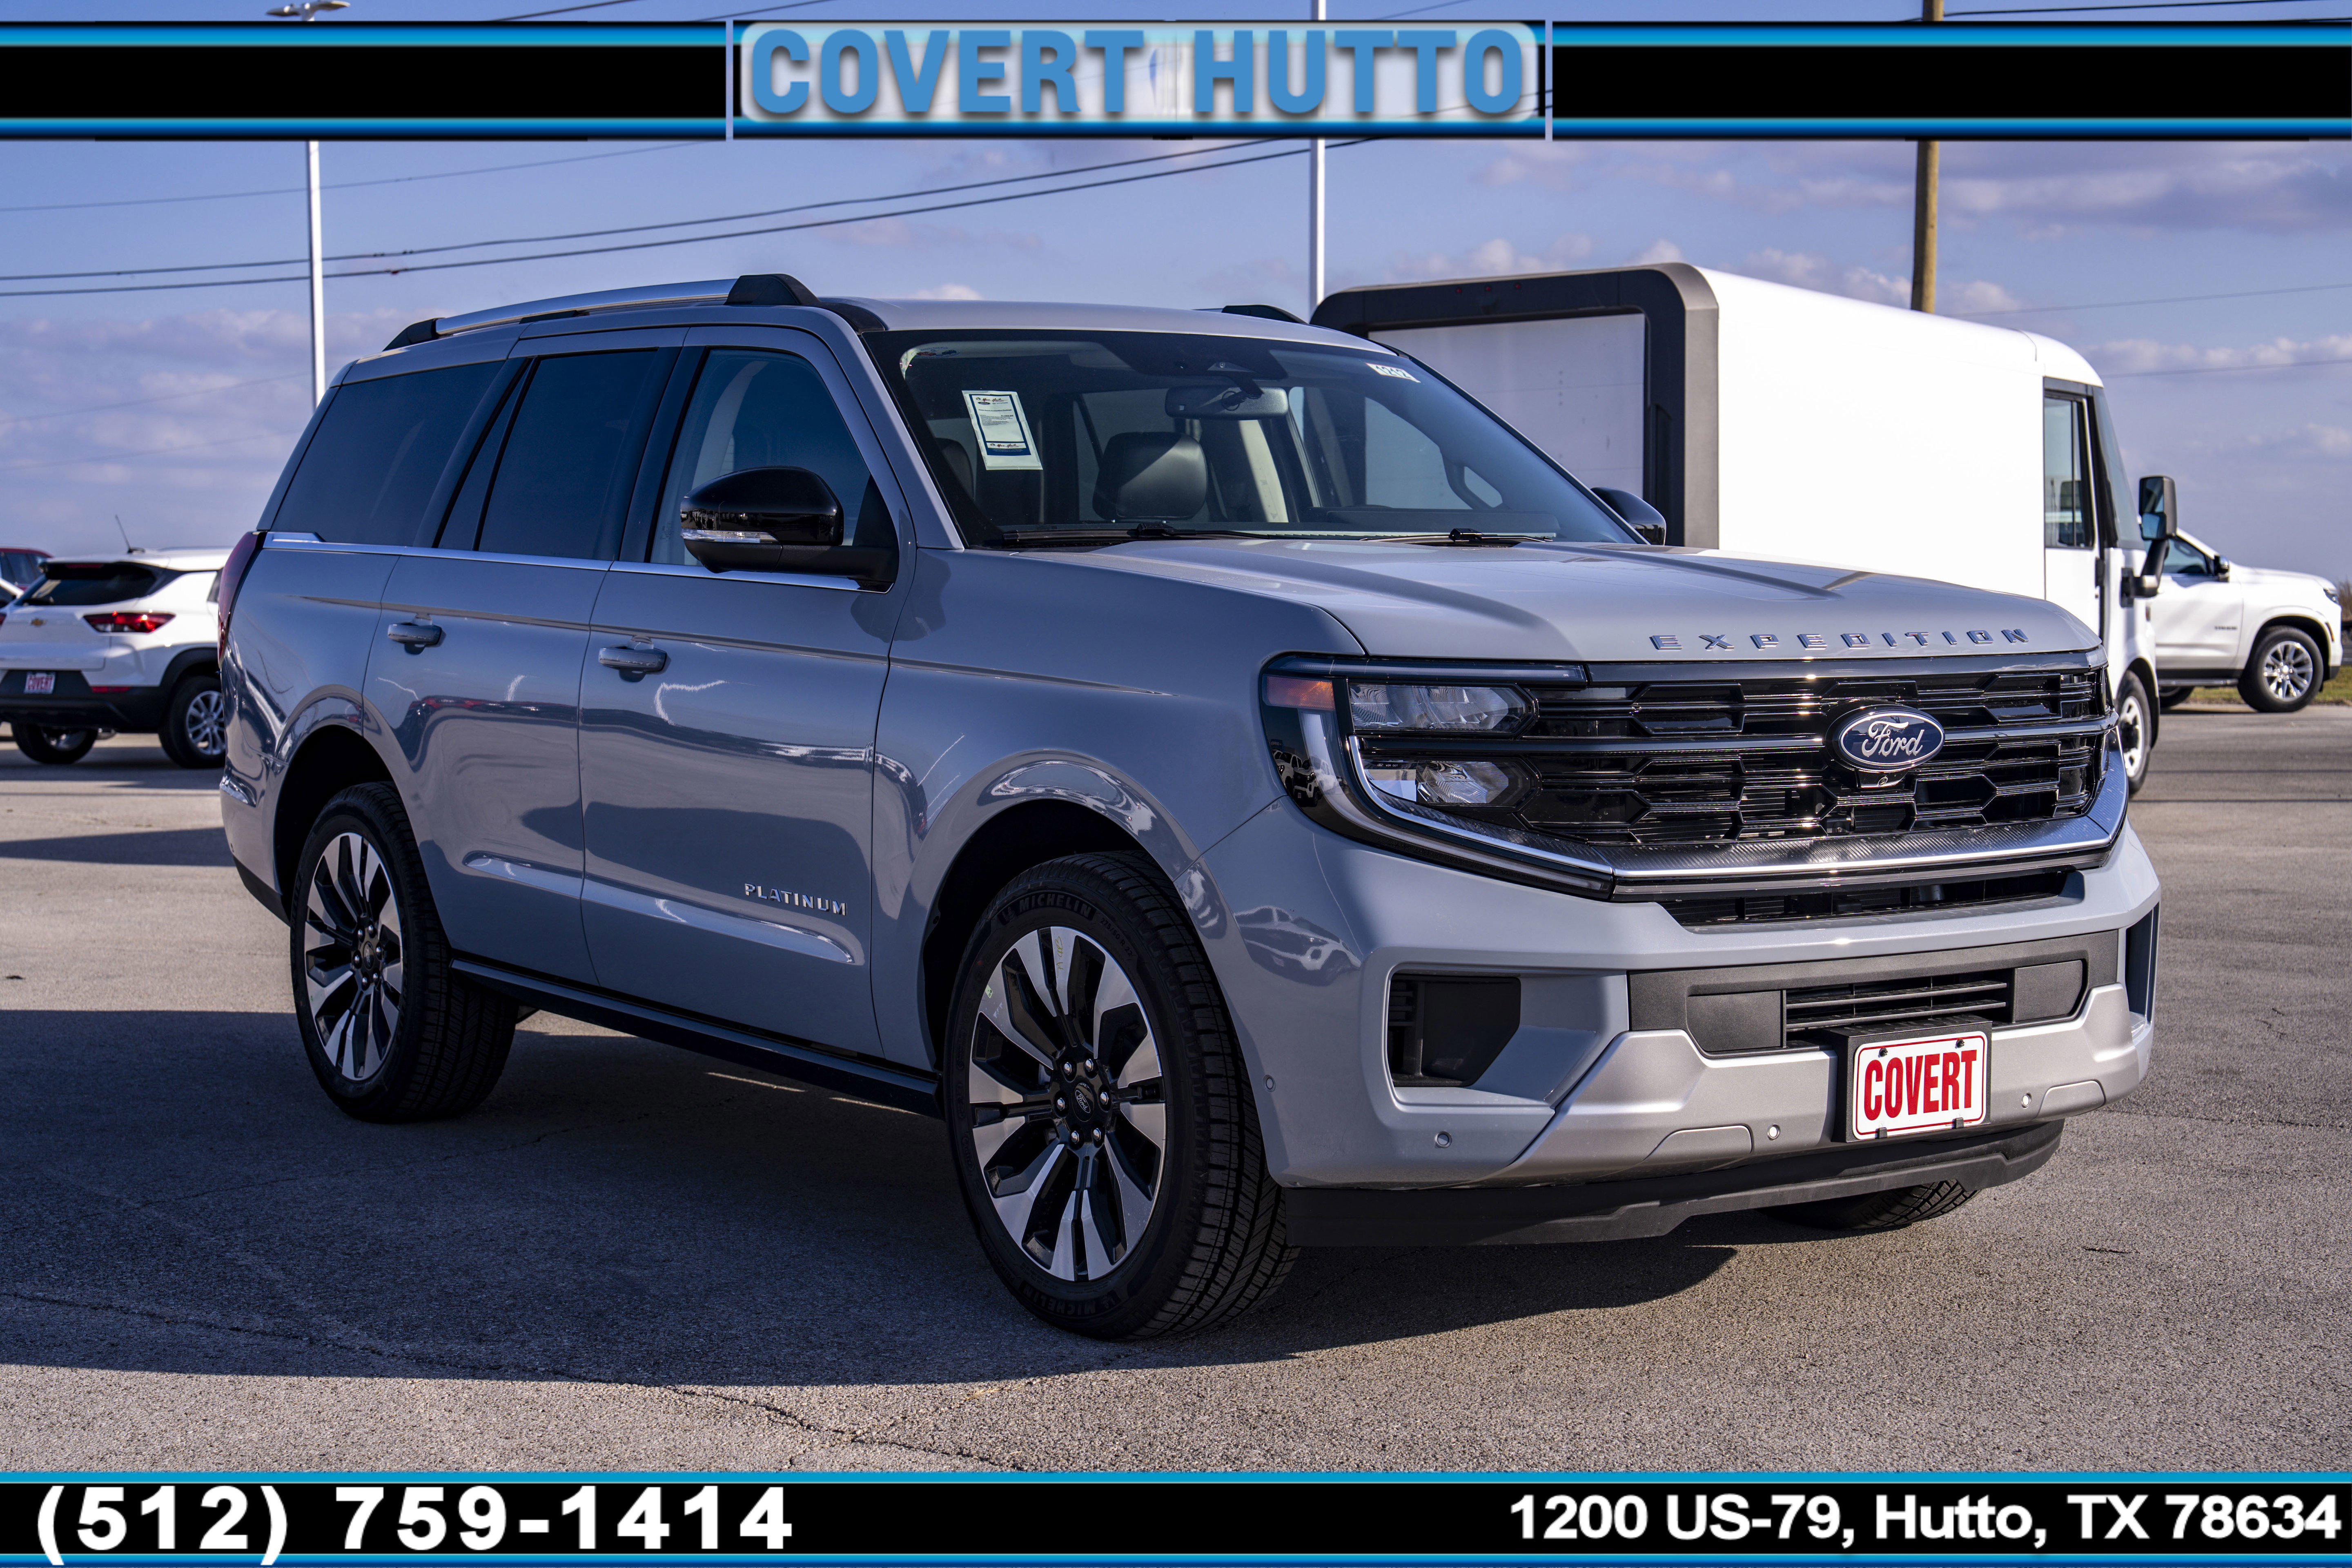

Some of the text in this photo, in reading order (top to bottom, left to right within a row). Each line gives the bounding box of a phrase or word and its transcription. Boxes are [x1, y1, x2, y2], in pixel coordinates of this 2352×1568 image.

[1376, 365, 1412, 379] 1212
[1649, 628, 2029, 650] EXPEDITION
[1861, 721, 1925, 757] Ford
[745, 883, 847, 916] PLATINUM
[1019, 893, 1091, 919] MICHELIN
[1101, 918, 1120, 940] 275/50
[1124, 946, 1132, 957] 22
[1864, 1049, 1977, 1121] COVERT
